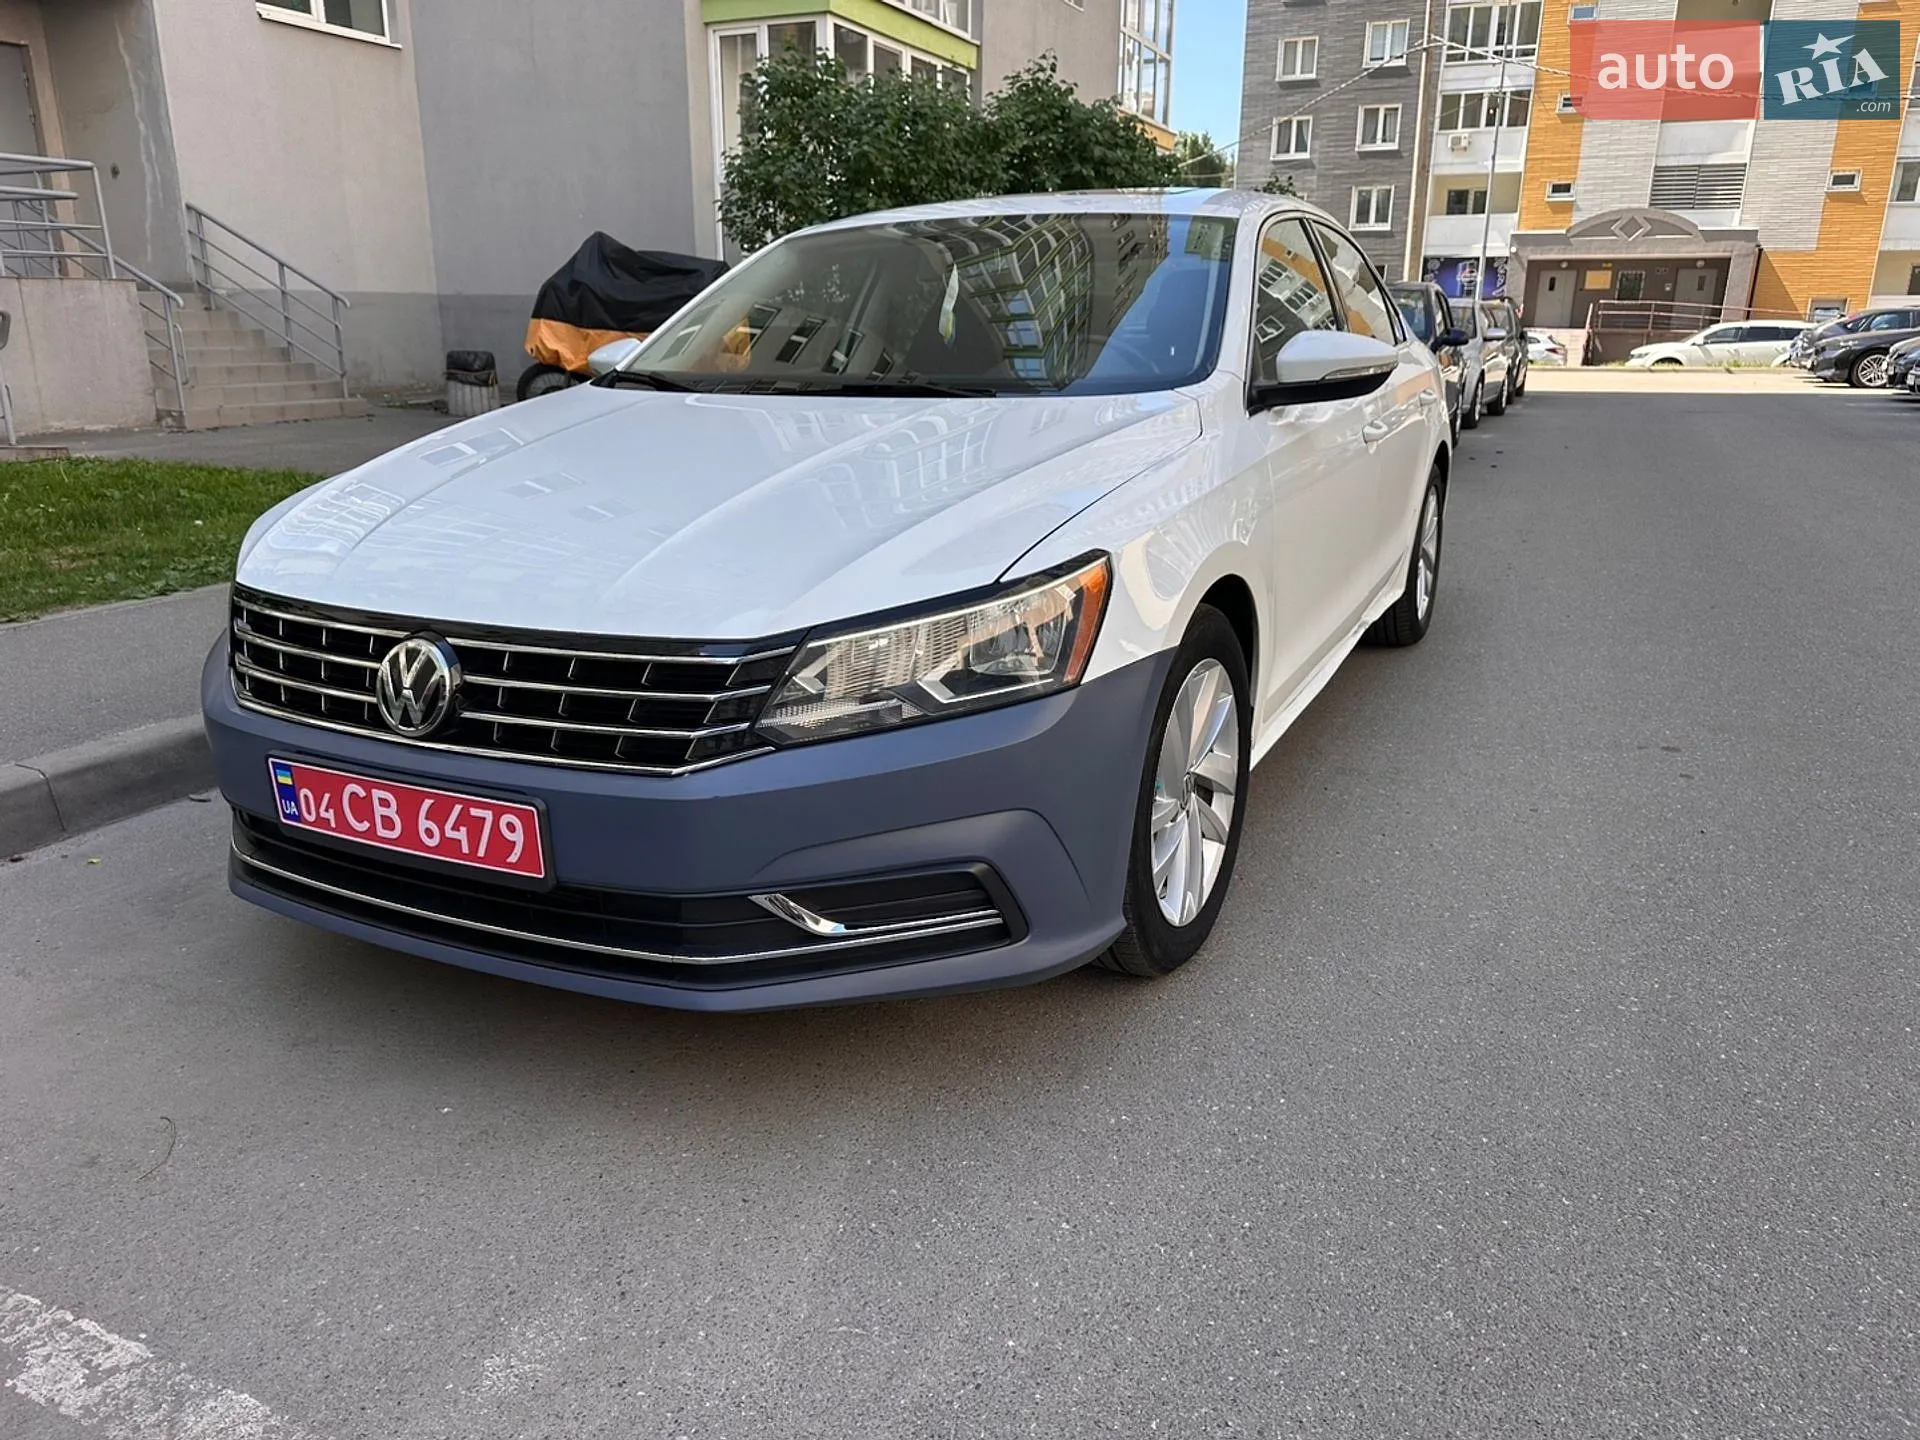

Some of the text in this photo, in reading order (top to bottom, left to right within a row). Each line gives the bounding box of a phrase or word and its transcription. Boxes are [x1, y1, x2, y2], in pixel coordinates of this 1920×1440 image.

[283, 800, 298, 816] UA
[300, 783, 524, 864] 04 CB 6479
